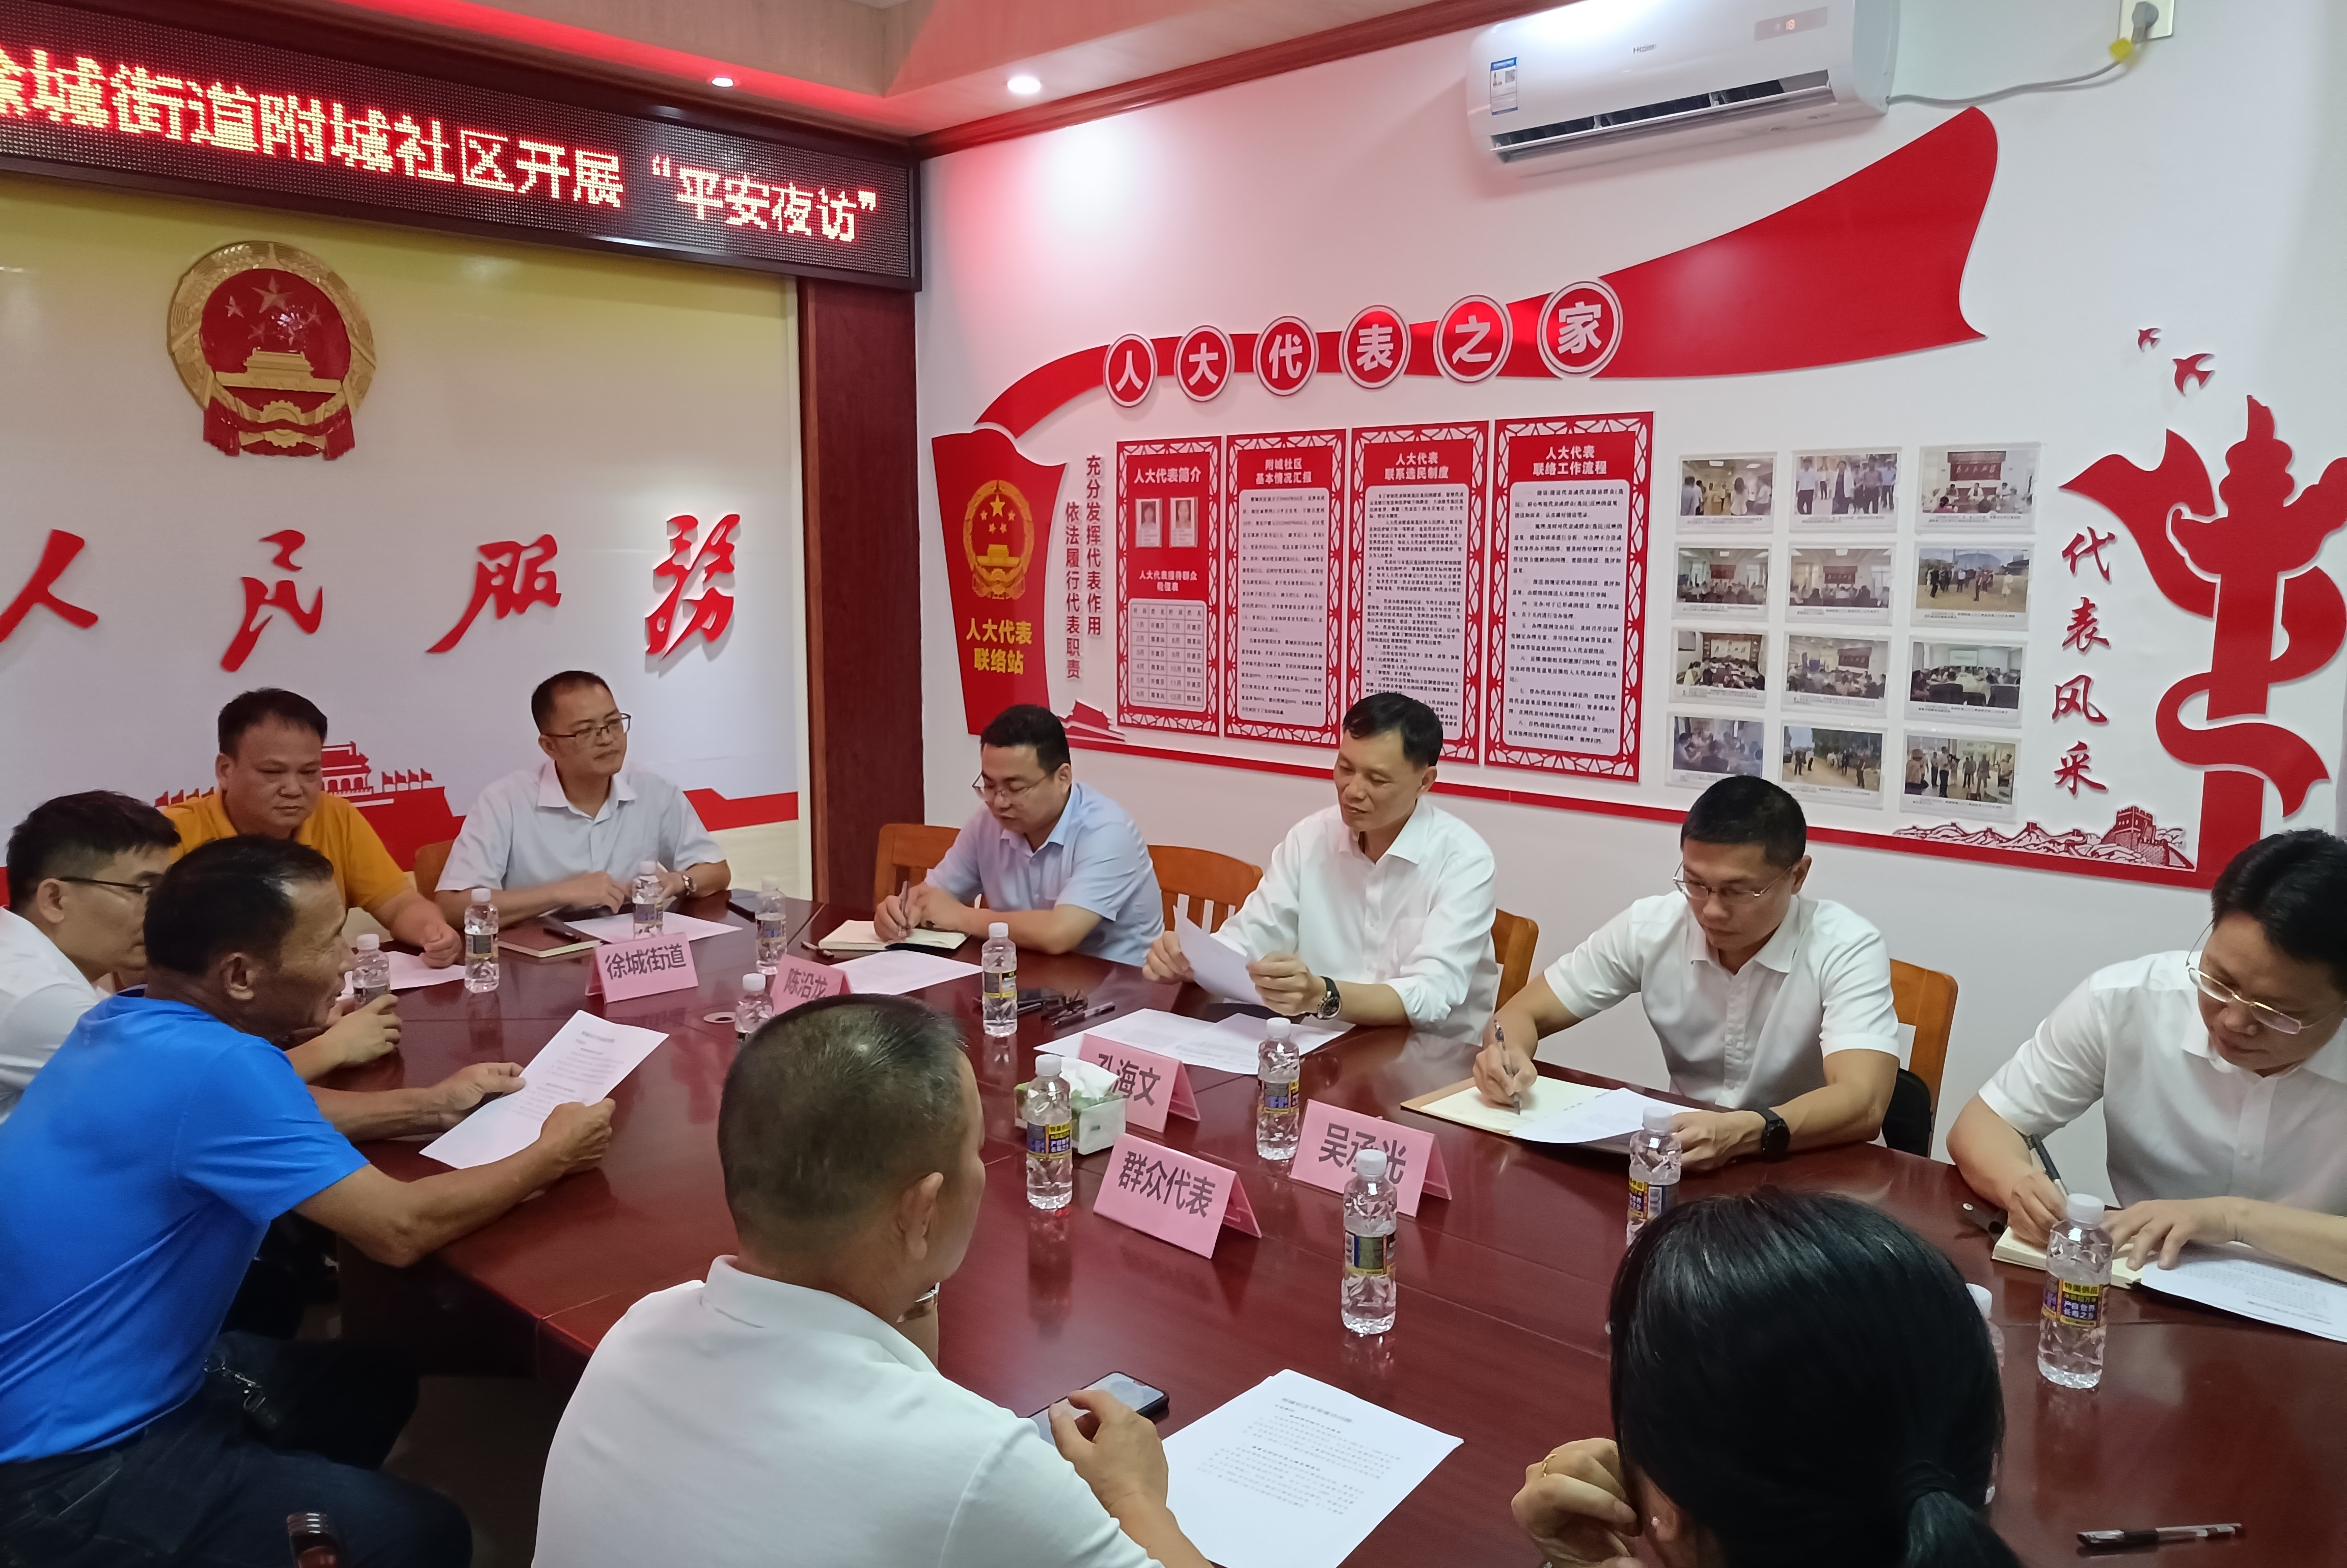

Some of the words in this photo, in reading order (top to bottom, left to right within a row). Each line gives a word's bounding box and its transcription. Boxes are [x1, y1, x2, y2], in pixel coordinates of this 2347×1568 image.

[1115, 301, 1602, 391] 人大代表之家
[1396, 451, 1438, 465] 人大代表
[1533, 460, 1607, 476] 联络工作流程
[1546, 445, 1595, 460] 人大代表
[1134, 466, 1201, 484] 人大代表简介
[1086, 455, 1102, 636] 充分发挥代表作用
[1065, 502, 1081, 679] 依法履行代表职责
[966, 618, 1033, 645] 人大代表
[974, 648, 1024, 675] 联络站
[2052, 526, 2116, 795] 代表风采
[605, 943, 687, 980] 徐城街道
[783, 968, 828, 1001] 陈沿龙
[1118, 1150, 1216, 1218] 群众代表
